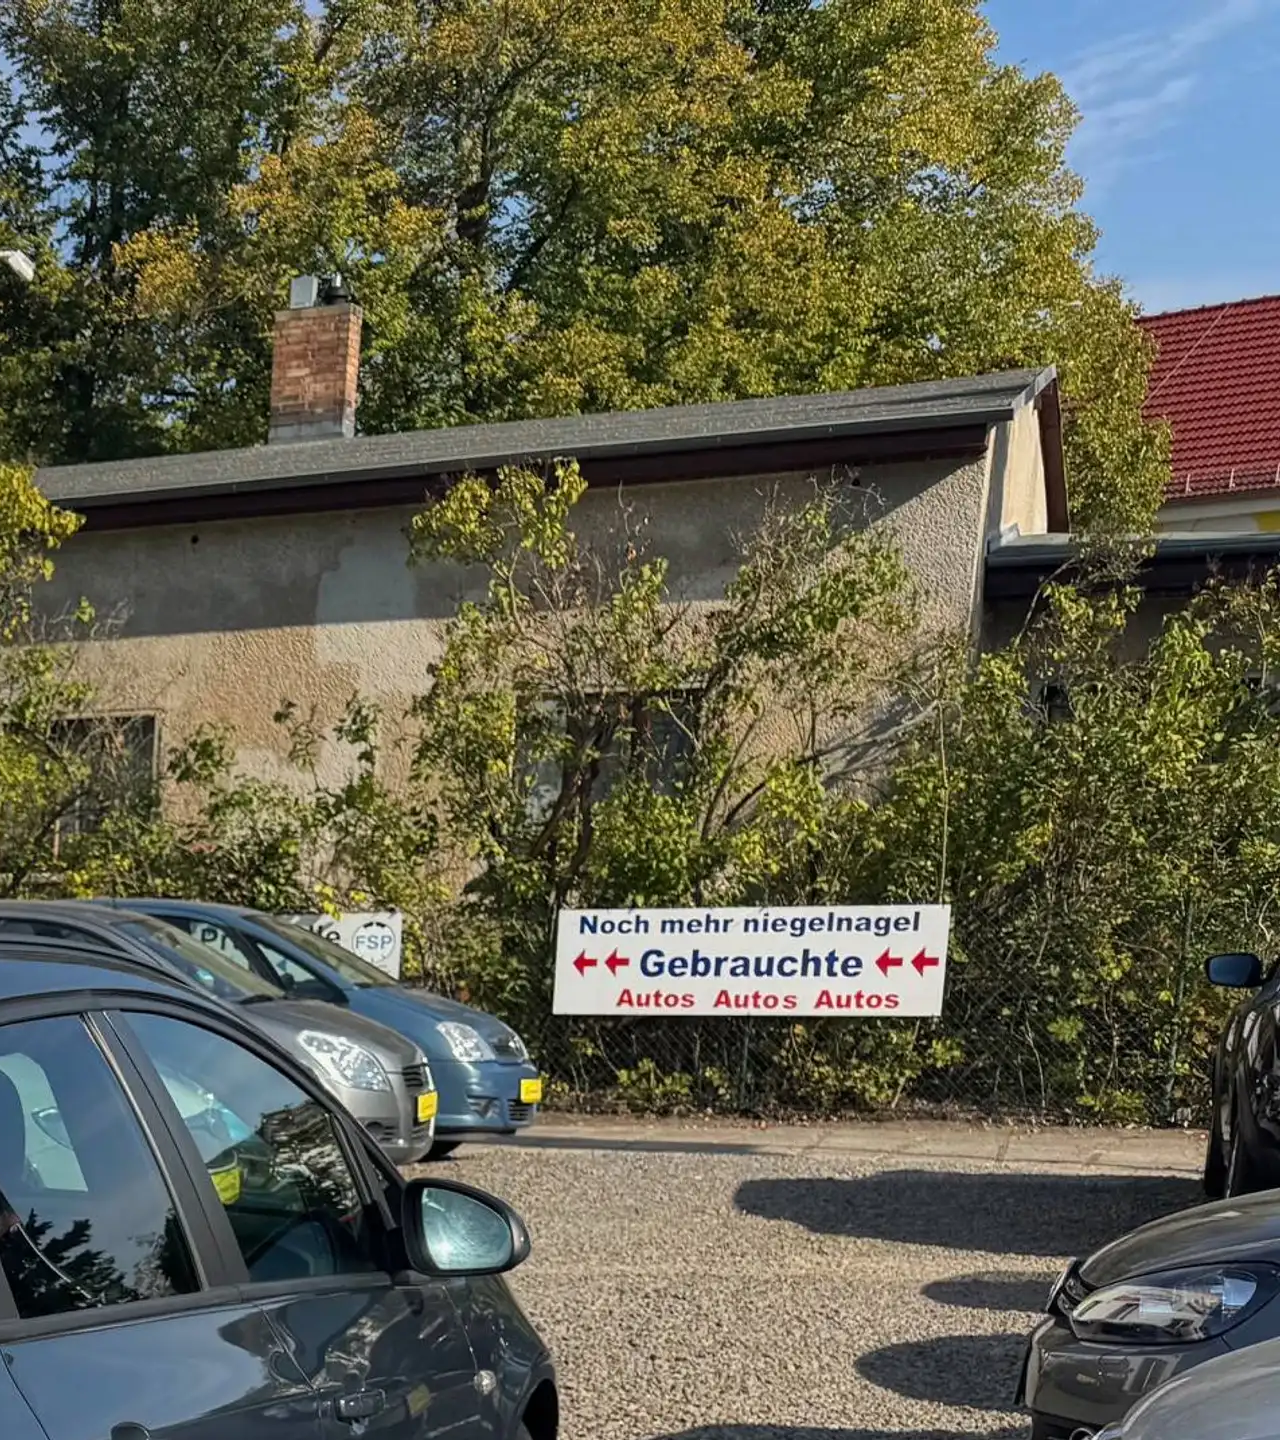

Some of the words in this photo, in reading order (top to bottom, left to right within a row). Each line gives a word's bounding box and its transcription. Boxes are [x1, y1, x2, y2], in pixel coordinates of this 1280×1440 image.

[579, 913, 650, 936] Noch
[660, 912, 734, 935] mehr
[743, 911, 920, 940] niegelnagel
[355, 934, 393, 951] FSP
[640, 948, 863, 979] Gebrauchte
[617, 988, 695, 1010] Autos
[714, 988, 798, 1011] Autos
[814, 988, 900, 1011] Autos
